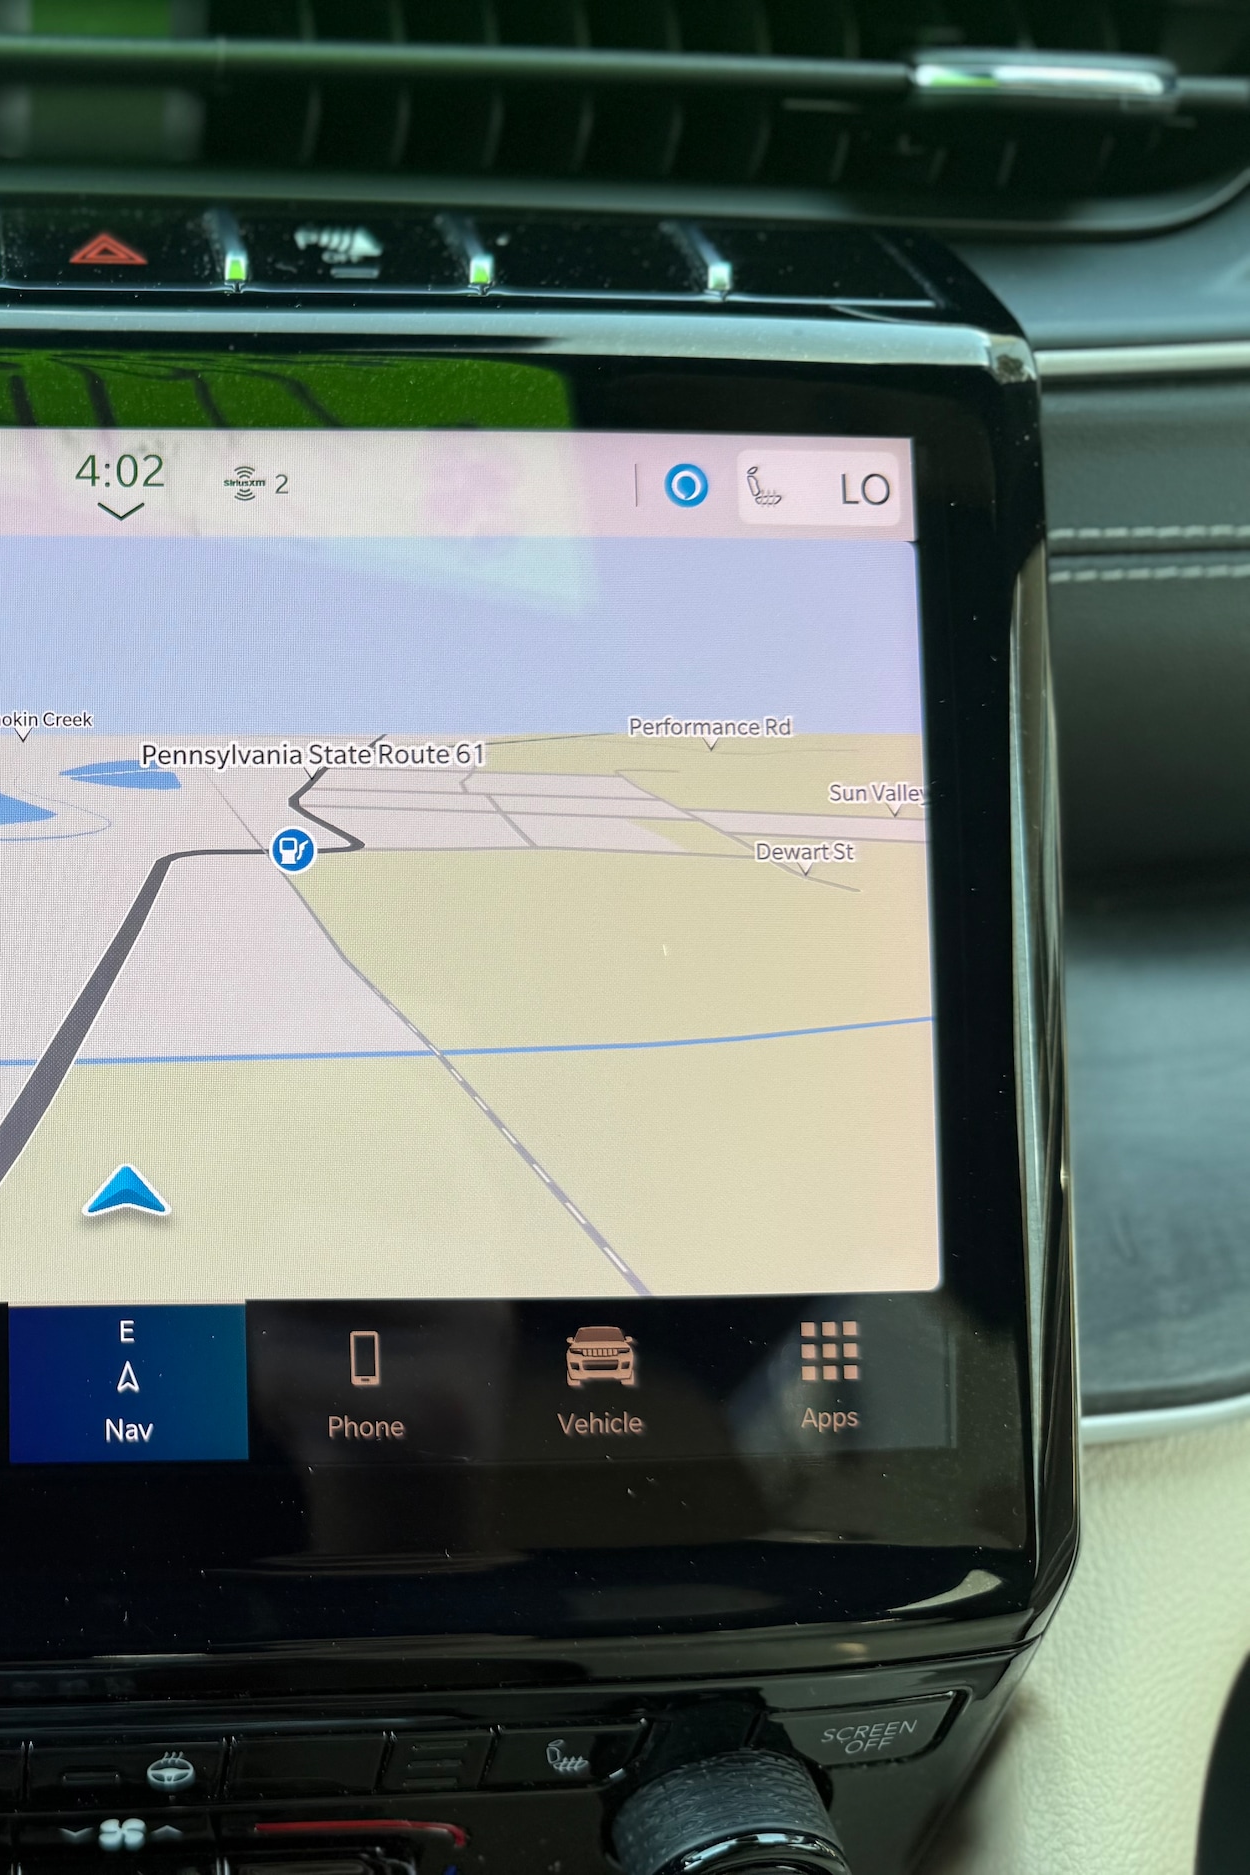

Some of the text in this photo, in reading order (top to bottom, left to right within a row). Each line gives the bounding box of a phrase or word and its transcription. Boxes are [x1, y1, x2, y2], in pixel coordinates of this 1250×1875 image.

[75, 454, 165, 488] 4:02
[275, 473, 289, 494] 2
[841, 473, 891, 506] LO
[43, 711, 93, 727] Creek
[629, 718, 792, 737] Performance Rd
[141, 743, 485, 769] Pennsylvania State Route 61
[829, 784, 867, 802] Sun
[755, 843, 855, 862] Dewart St
[119, 1320, 135, 1343] E
[105, 1418, 154, 1443] Nav
[328, 1415, 405, 1439] Phone
[557, 1411, 644, 1435] Vehicle
[800, 1407, 860, 1433] Apps
[821, 1720, 918, 1743] SCREEN
[845, 1736, 895, 1754] OFF
